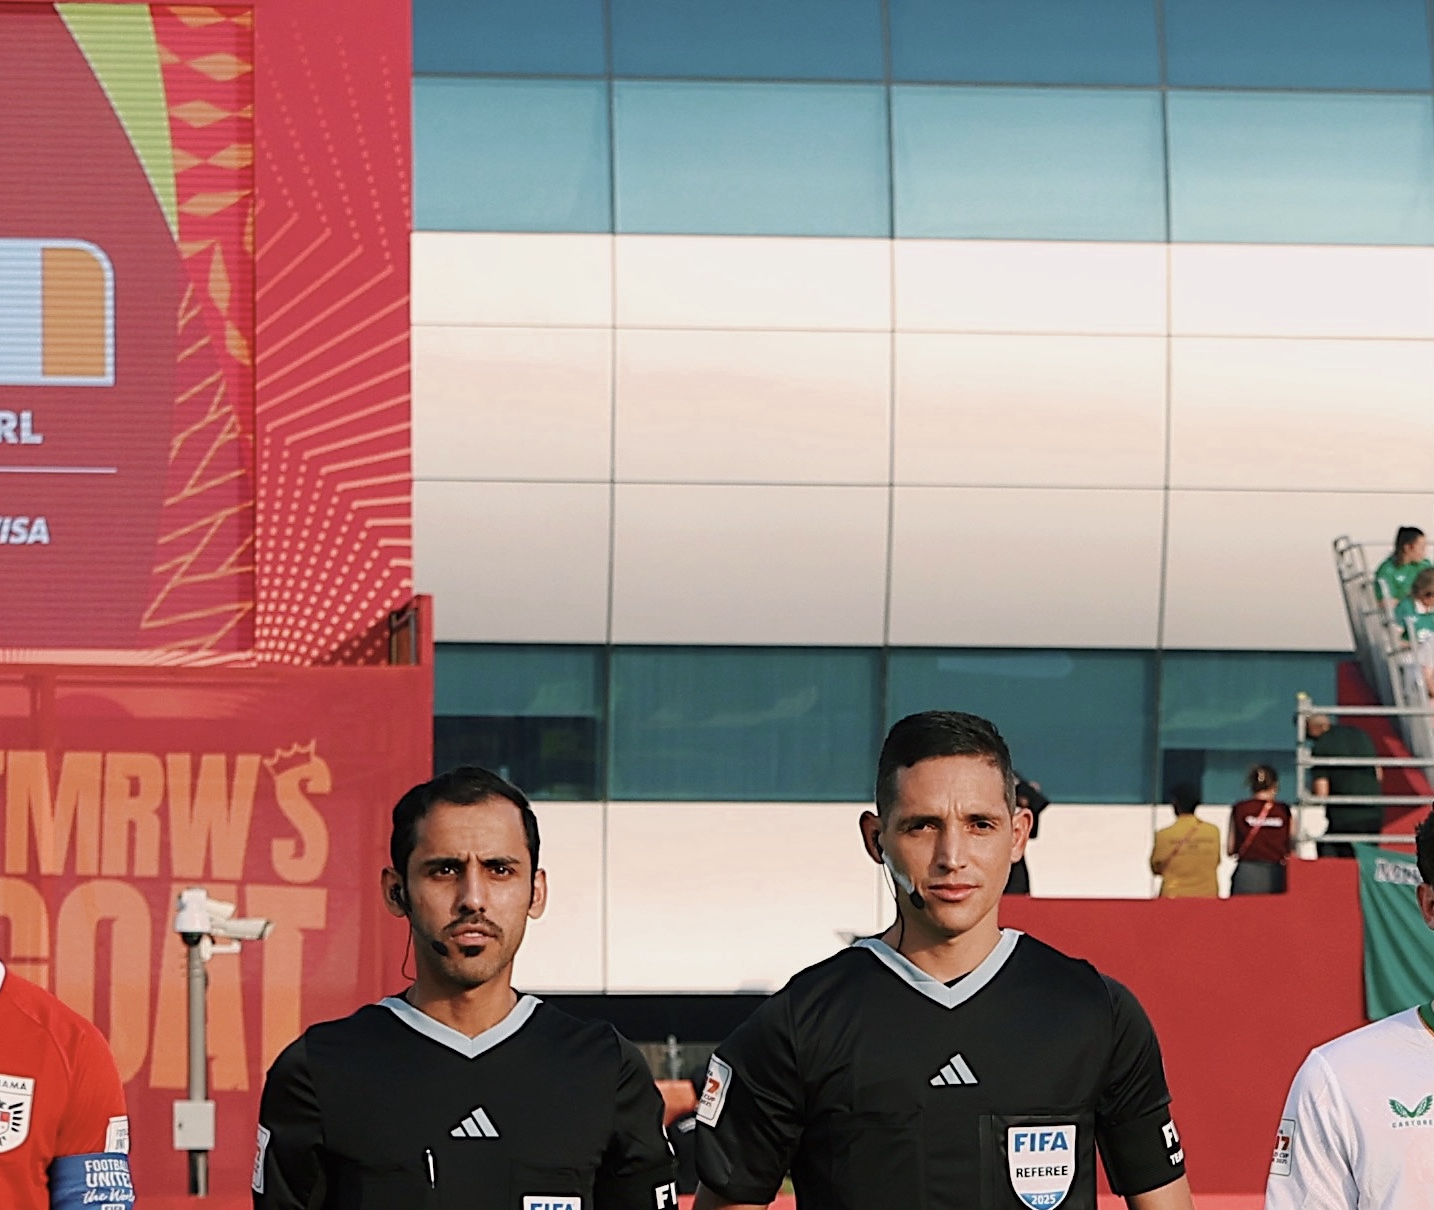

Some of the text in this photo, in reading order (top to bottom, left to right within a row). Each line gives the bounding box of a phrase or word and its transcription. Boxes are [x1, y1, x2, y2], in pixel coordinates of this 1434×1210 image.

[1392, 1119, 1433, 1129] CASTORE
[1014, 1131, 1069, 1153] FIFA
[1016, 1165, 1068, 1178] REFEREE
[82, 1188, 107, 1204] the
[1031, 1194, 1057, 1205] 2025
